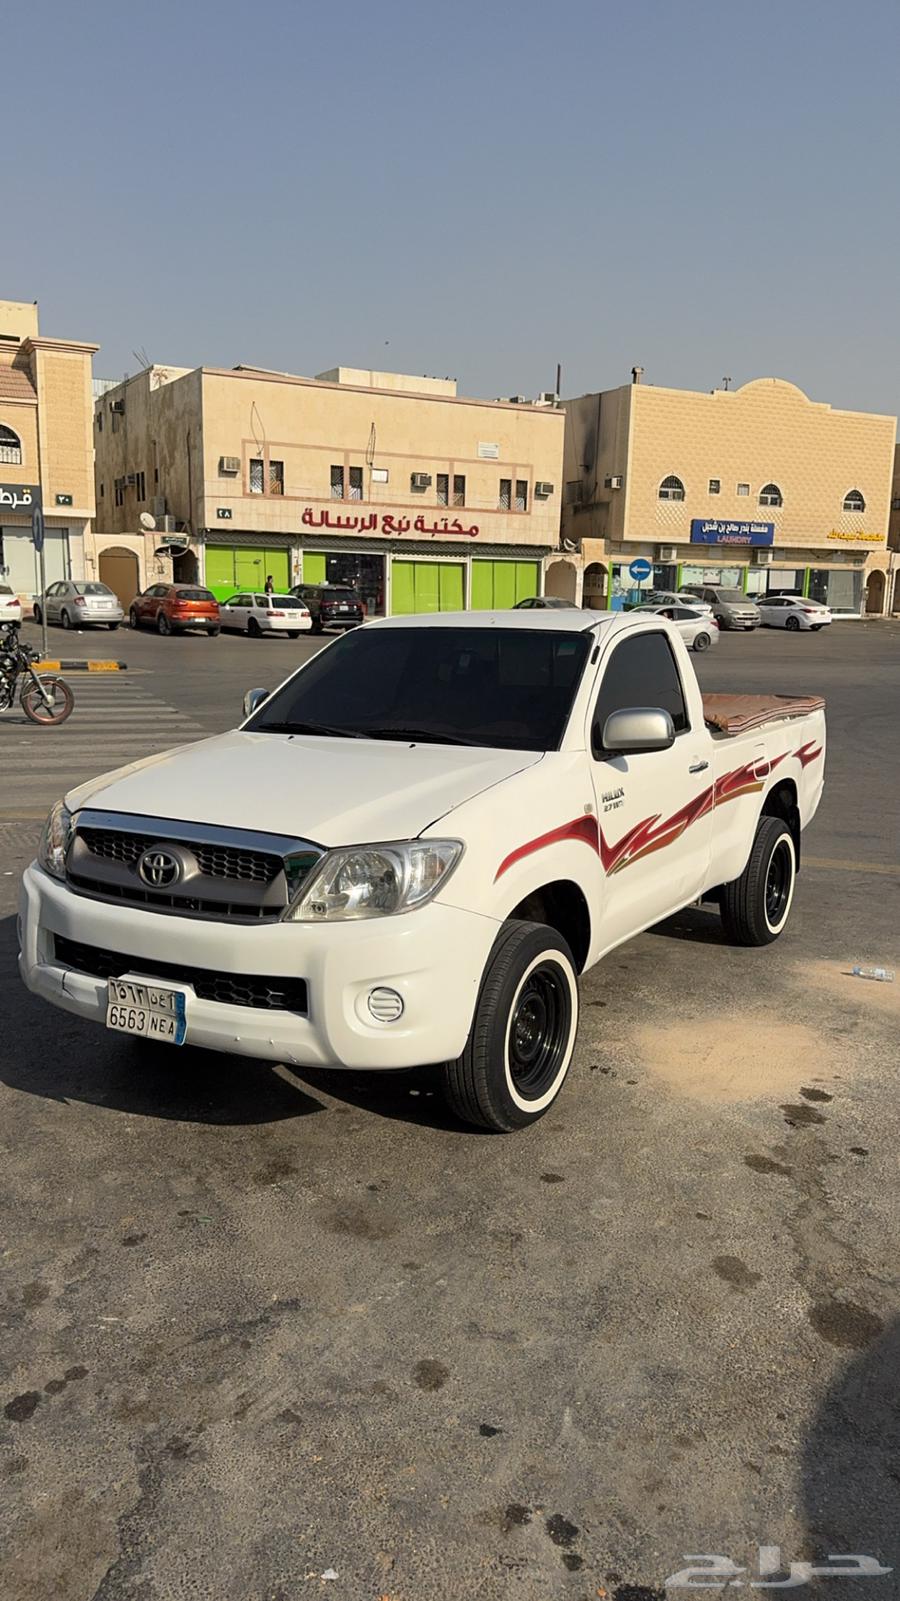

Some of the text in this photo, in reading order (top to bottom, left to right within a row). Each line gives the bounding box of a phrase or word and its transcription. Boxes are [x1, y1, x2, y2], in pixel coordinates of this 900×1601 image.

[0, 488, 32, 509] قرط
[301, 508, 480, 537] مكتبة نبع الرسالة
[718, 521, 726, 533] بن
[716, 535, 752, 544] LAUNDRY
[602, 787, 625, 803] HILUX
[110, 981, 144, 1005] ٦٥٦٣
[110, 1006, 175, 1035] 6563 NEA
